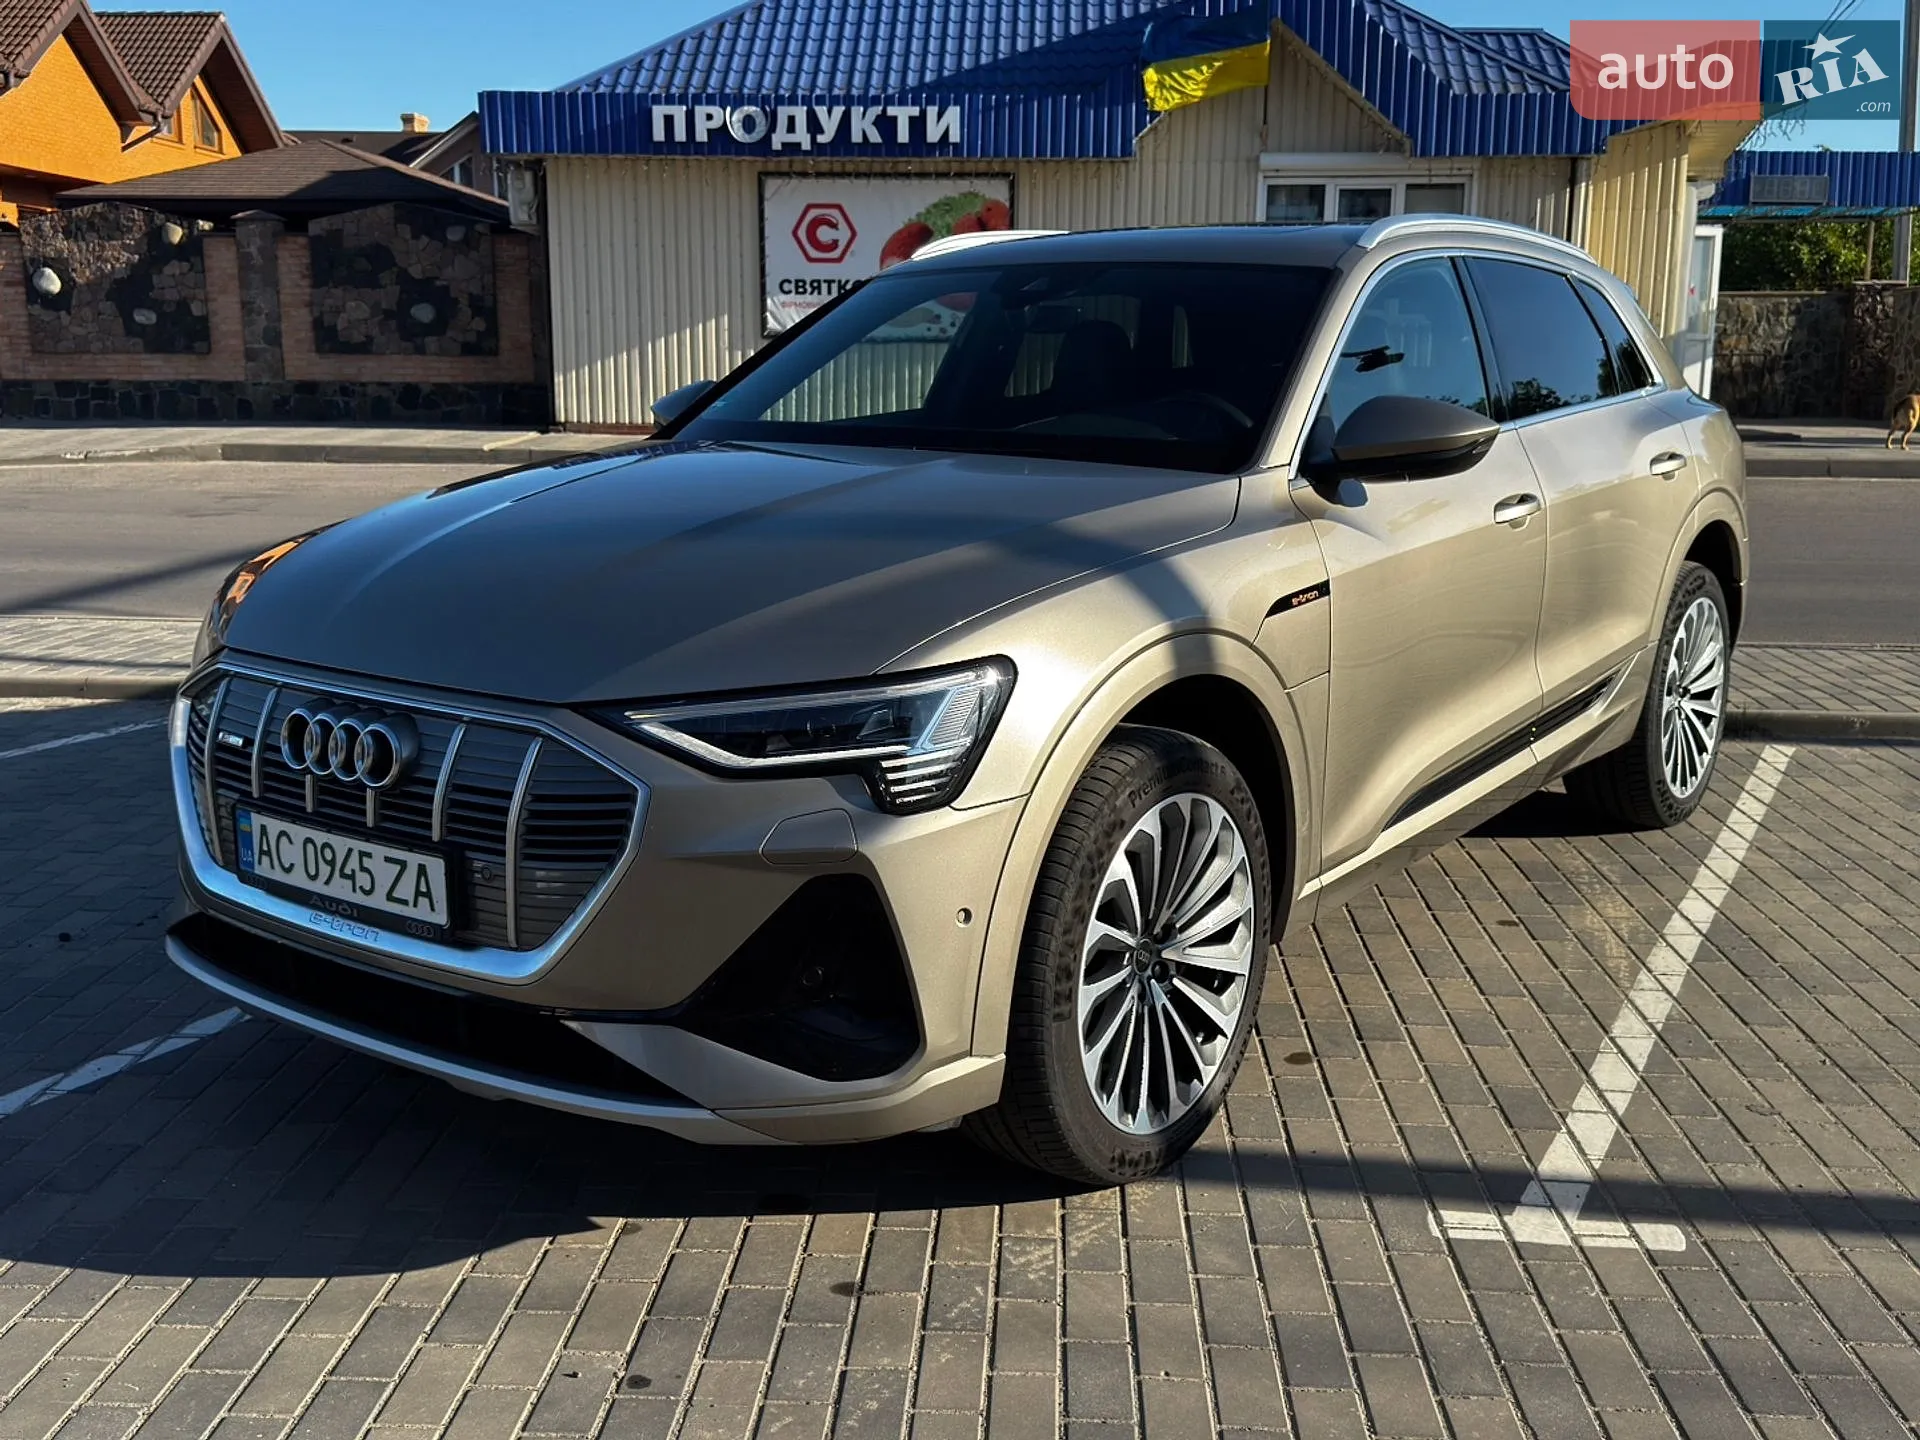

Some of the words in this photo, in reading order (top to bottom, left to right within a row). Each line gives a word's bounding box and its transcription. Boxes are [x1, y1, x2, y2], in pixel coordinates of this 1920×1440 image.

[651, 105, 961, 150] ПРОДУКТИ
[257, 824, 295, 874] AC
[303, 837, 375, 896] 0945
[384, 856, 435, 912] ZA
